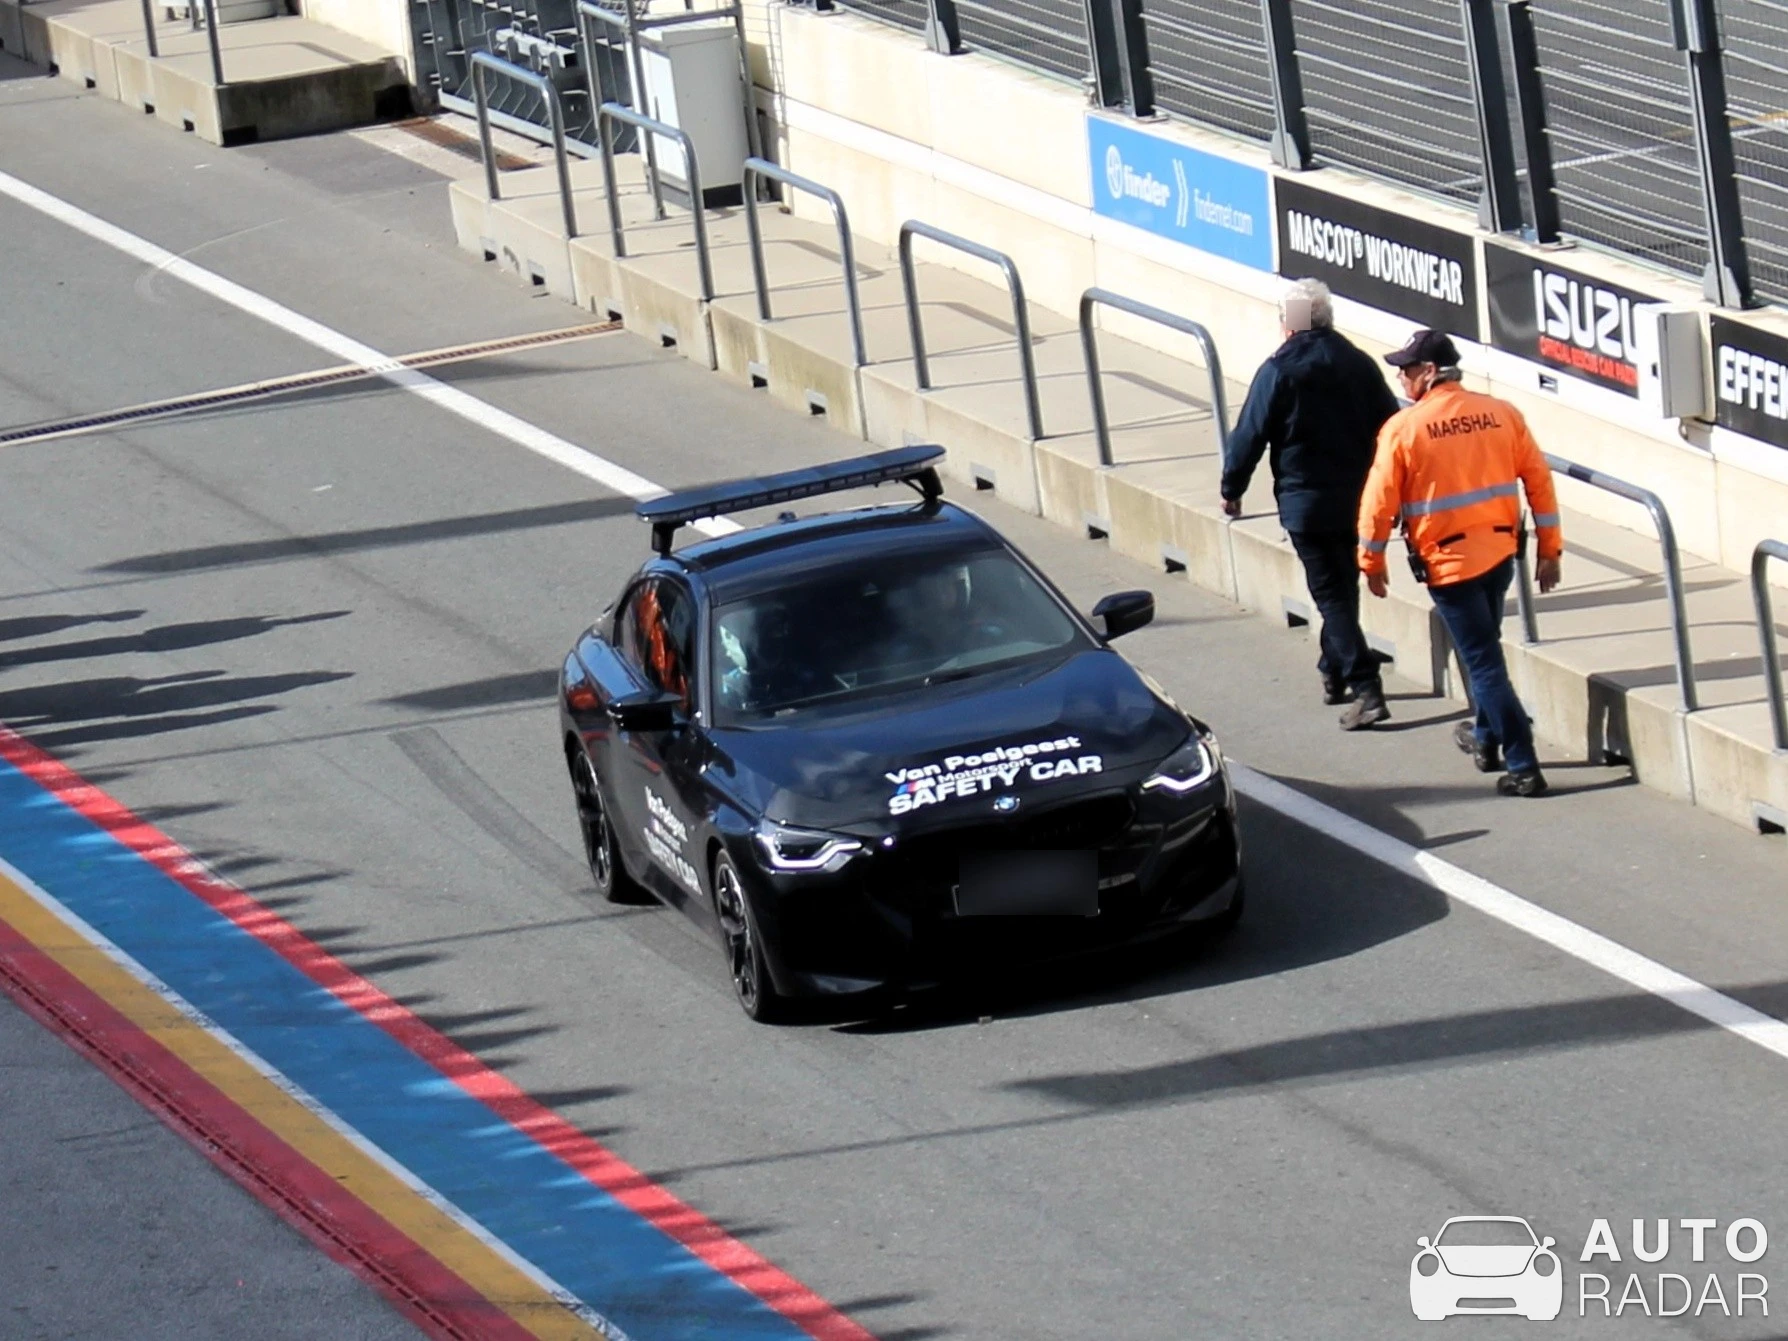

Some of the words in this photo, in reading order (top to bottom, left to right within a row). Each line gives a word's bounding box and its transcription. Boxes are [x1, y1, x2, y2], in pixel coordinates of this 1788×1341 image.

[1123, 164, 1170, 208] finder
[1364, 234, 1464, 306] WORKWEAR
[1426, 412, 1501, 440] MARSHAL
[885, 764, 941, 784] Van
[944, 736, 1082, 771] Poelgeest
[888, 768, 1021, 815] SAFETY
[1030, 755, 1102, 781] CAR
